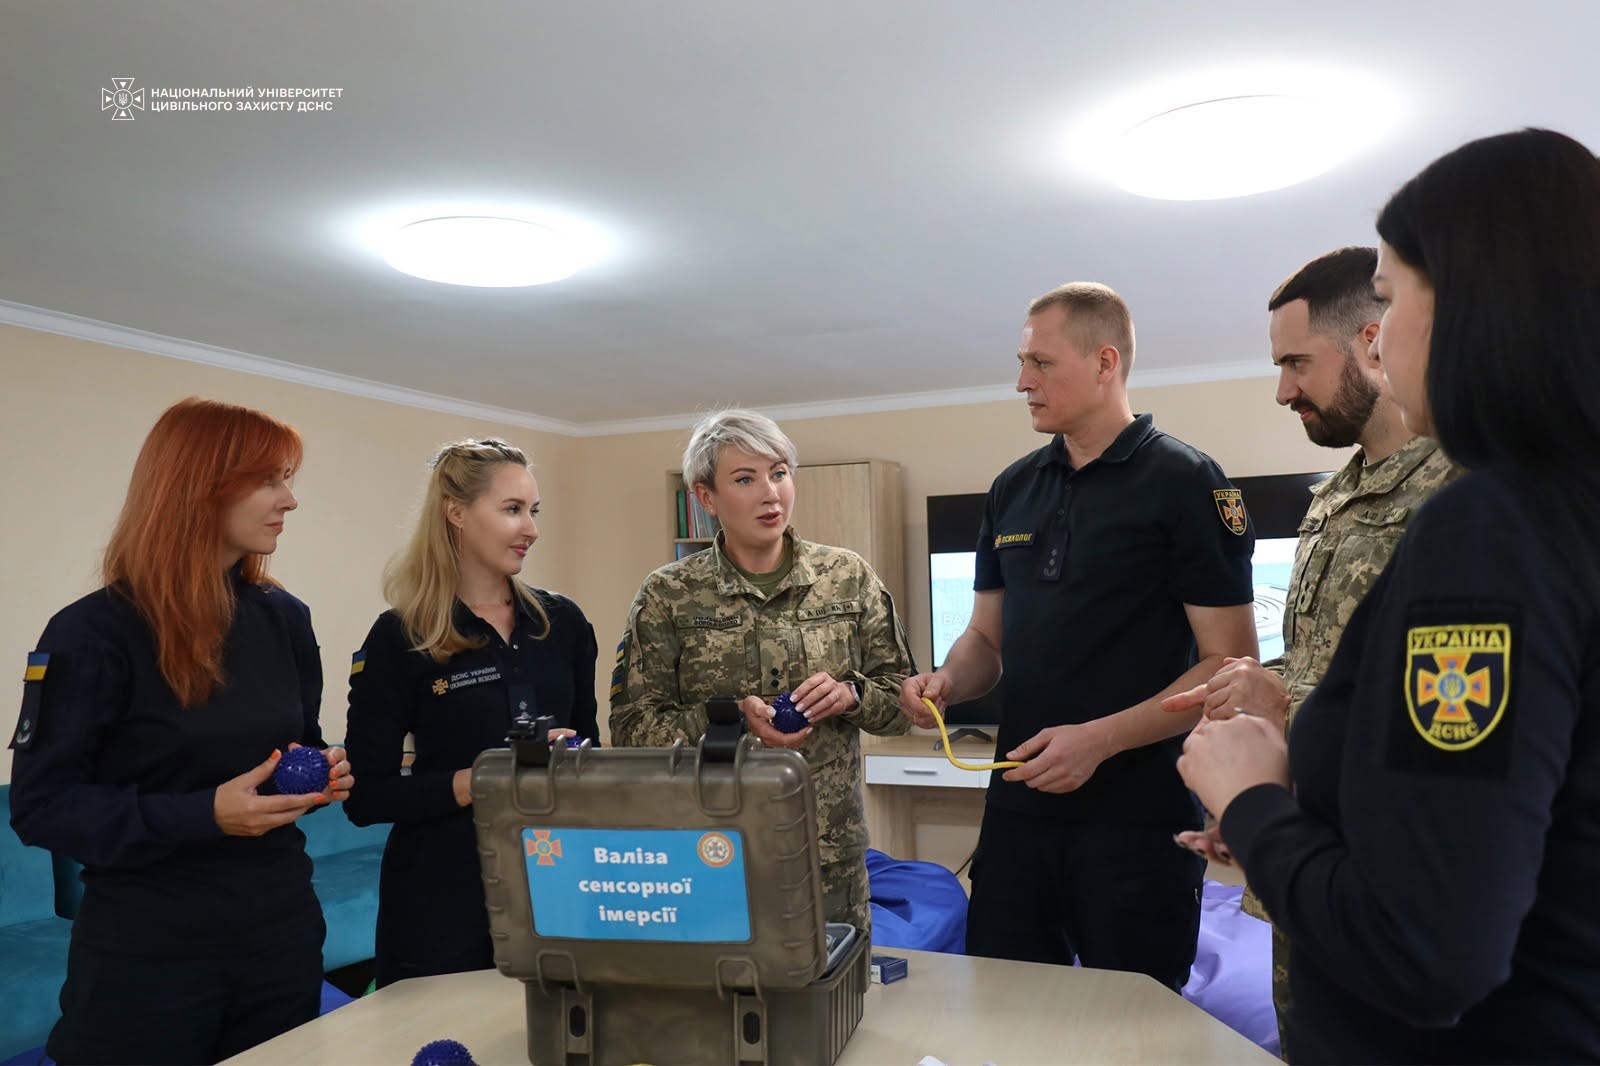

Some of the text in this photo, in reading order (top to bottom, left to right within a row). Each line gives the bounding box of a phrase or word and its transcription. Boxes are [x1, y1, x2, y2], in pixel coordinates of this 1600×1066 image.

[1412, 630, 1503, 649] УКРАЇНА
[1429, 721, 1479, 740] ДСНС
[593, 847, 668, 865] Валіза
[578, 877, 693, 898] сенсорної
[598, 905, 677, 926] імерсії
